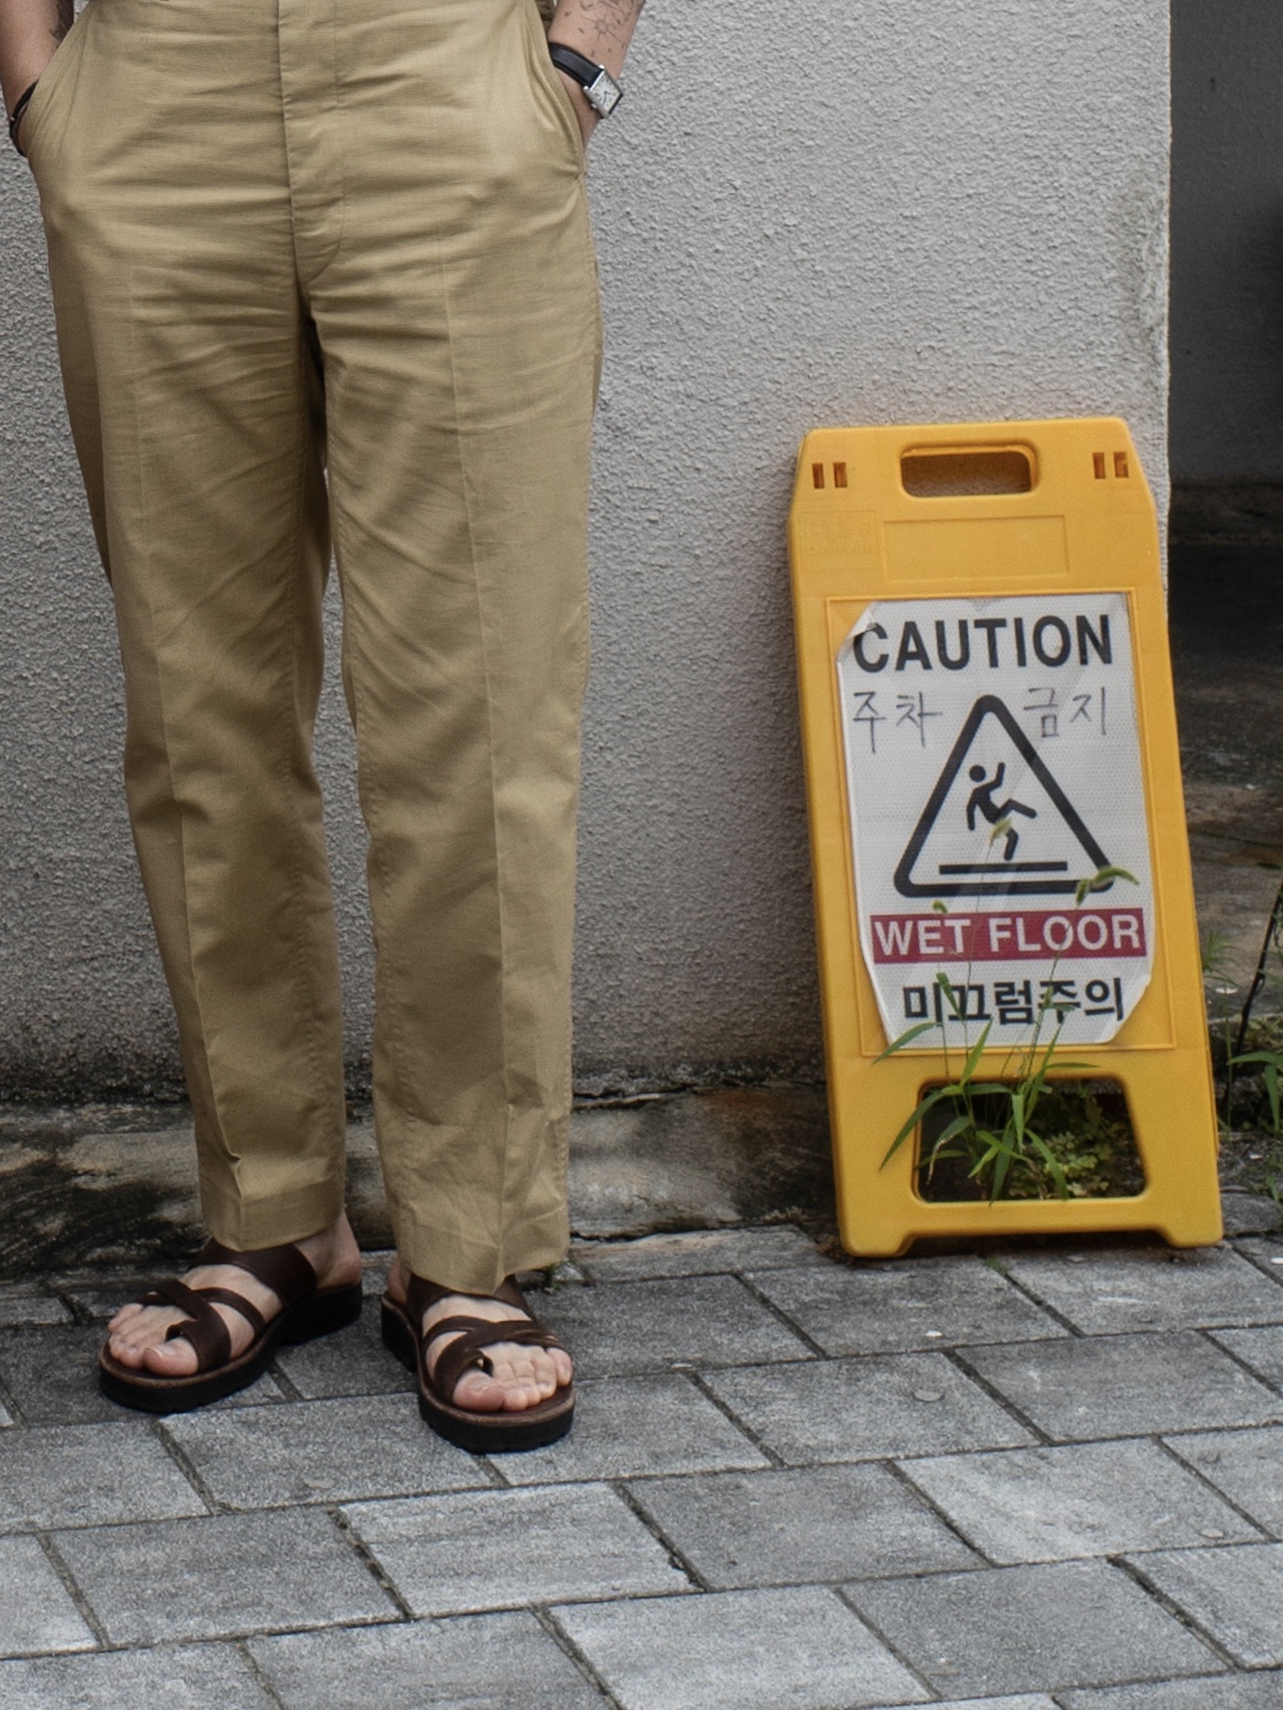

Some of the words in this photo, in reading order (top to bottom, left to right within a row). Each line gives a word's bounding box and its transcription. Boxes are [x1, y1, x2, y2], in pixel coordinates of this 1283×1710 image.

[853, 615, 1112, 672] CAUTION
[853, 692, 942, 754] 주차
[1023, 686, 1107, 738] 금지
[875, 920, 971, 956] WET
[990, 915, 1141, 953] FLOOR
[903, 979, 1124, 1025] 미끄럼주의
